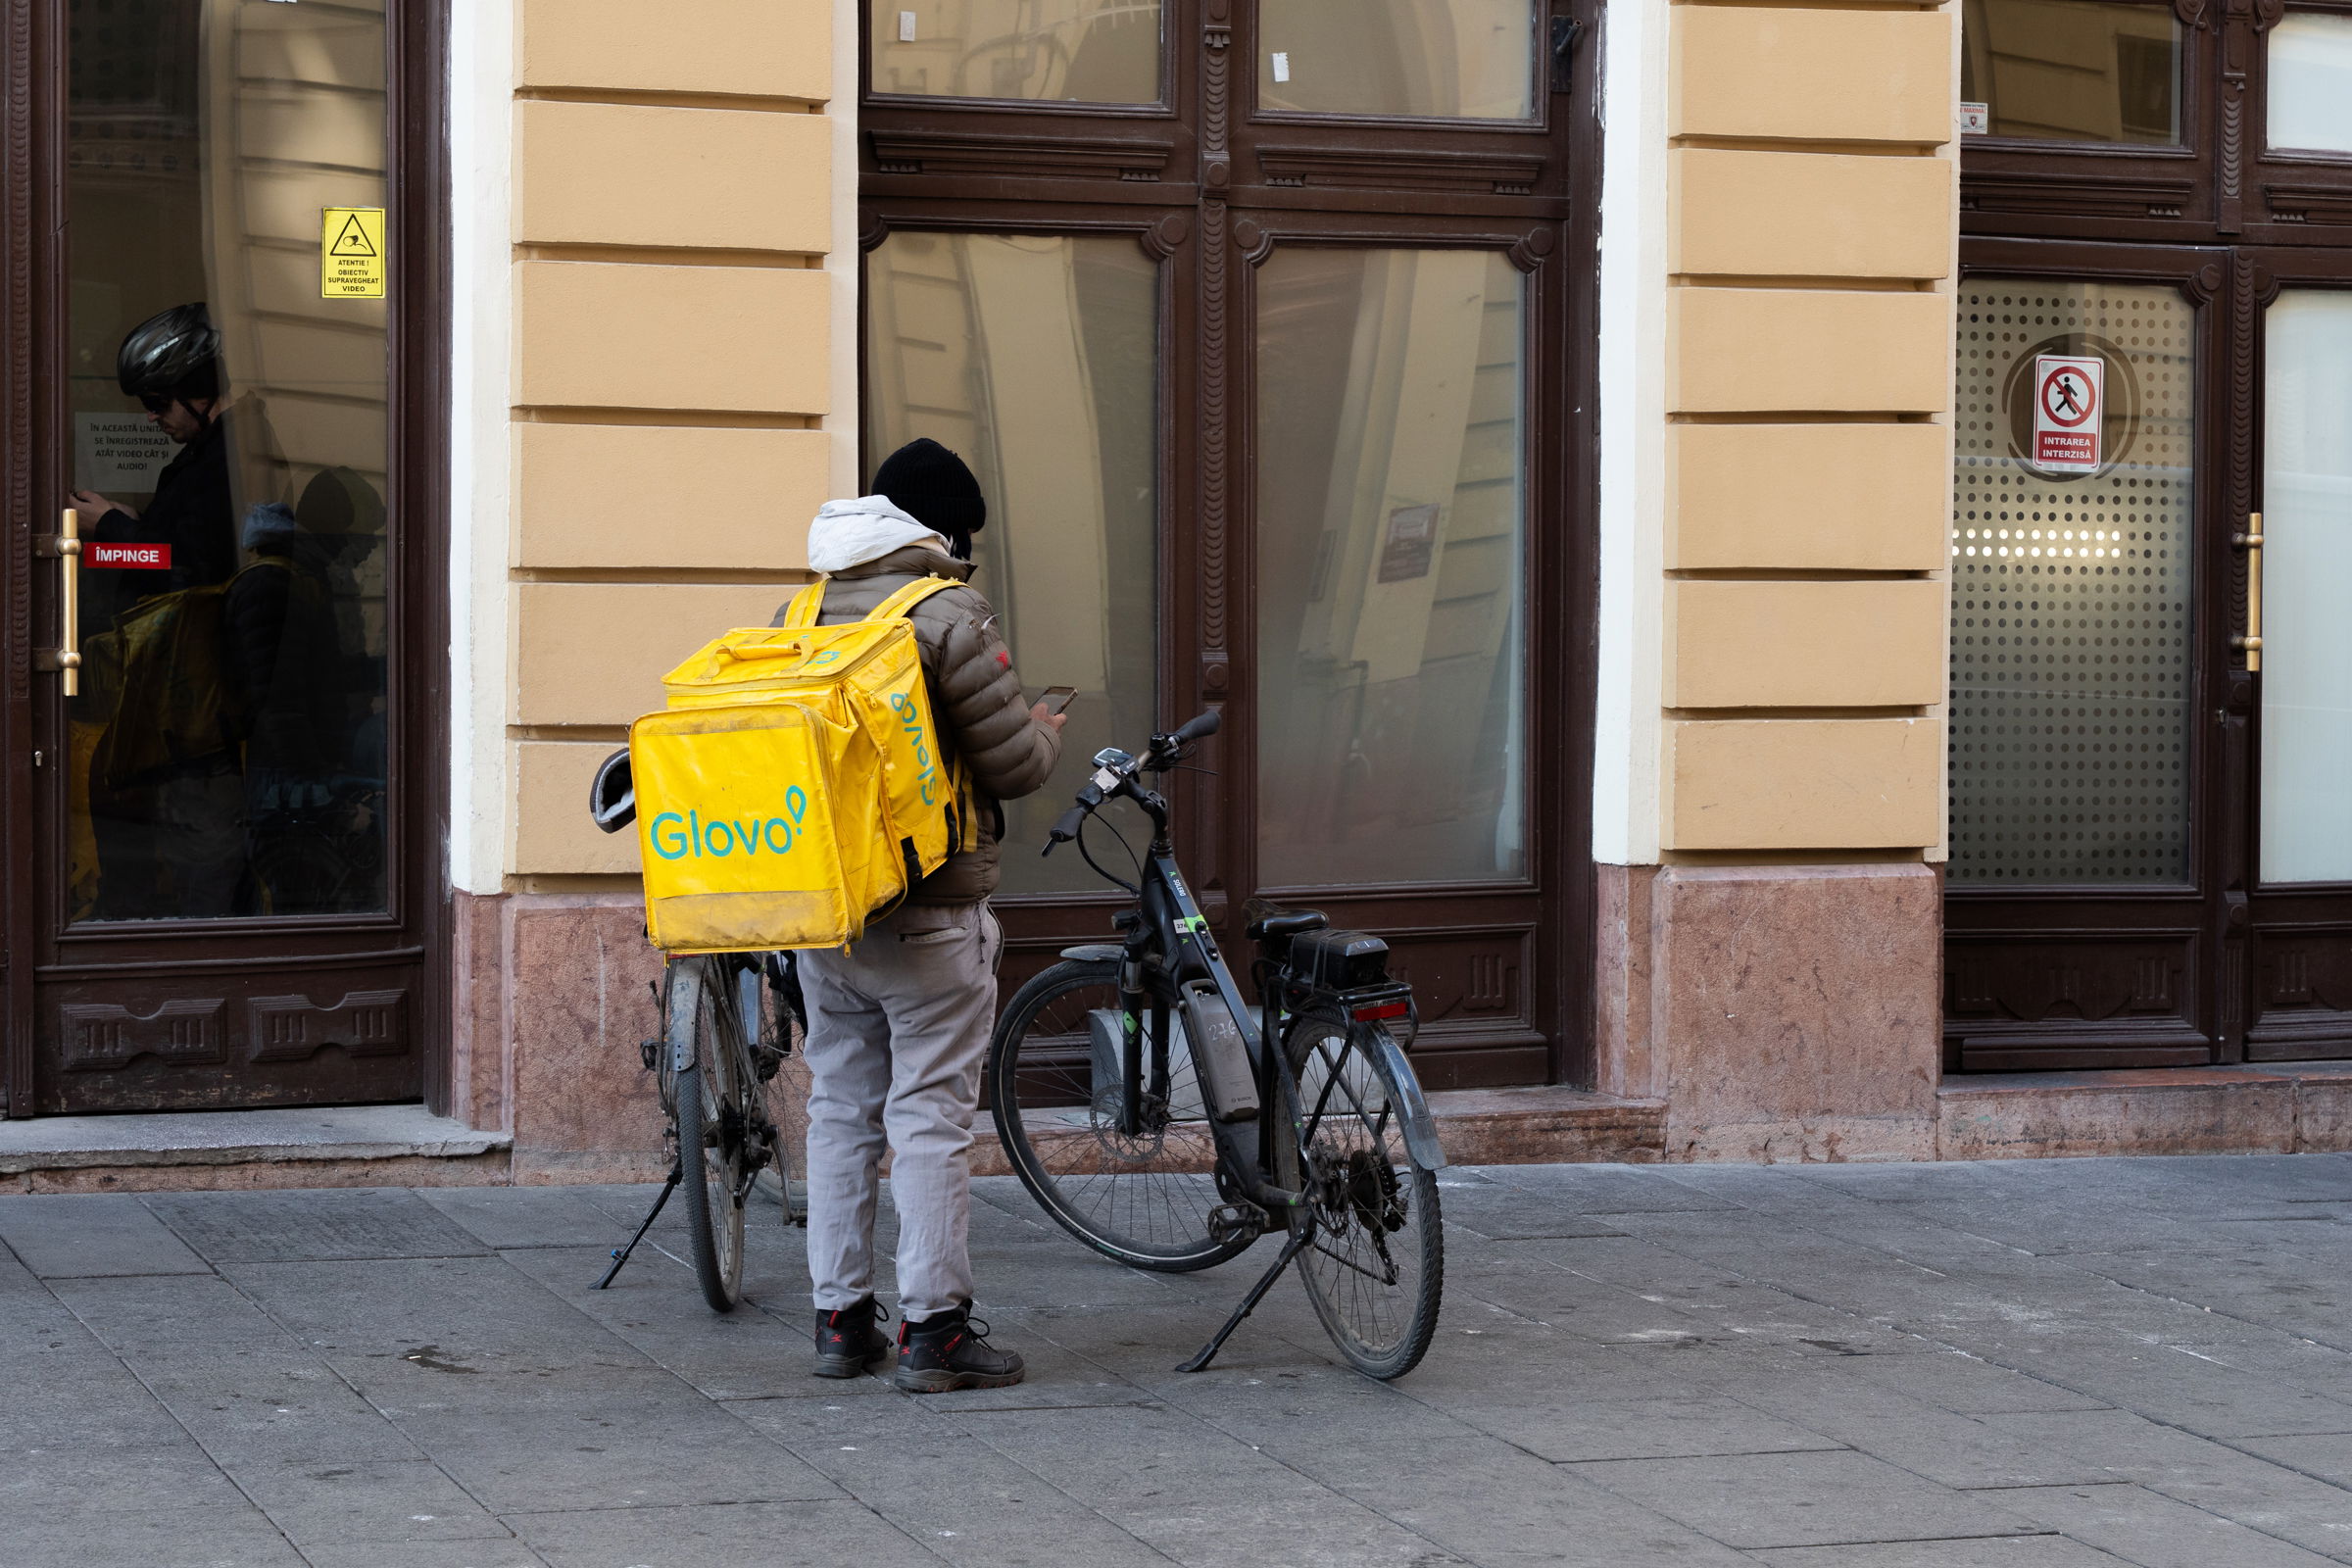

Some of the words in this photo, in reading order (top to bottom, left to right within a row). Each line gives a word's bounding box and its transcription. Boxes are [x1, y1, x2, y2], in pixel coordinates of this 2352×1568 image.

[102, 422, 137, 432] ACEASTĂ
[2044, 437, 2090, 446] INTRAREA
[144, 449, 159, 458] CÂT
[2042, 449, 2091, 459] INTERZISĂ
[95, 546, 160, 563] ÎMPINGE
[1172, 878, 1187, 897] SOLERO
